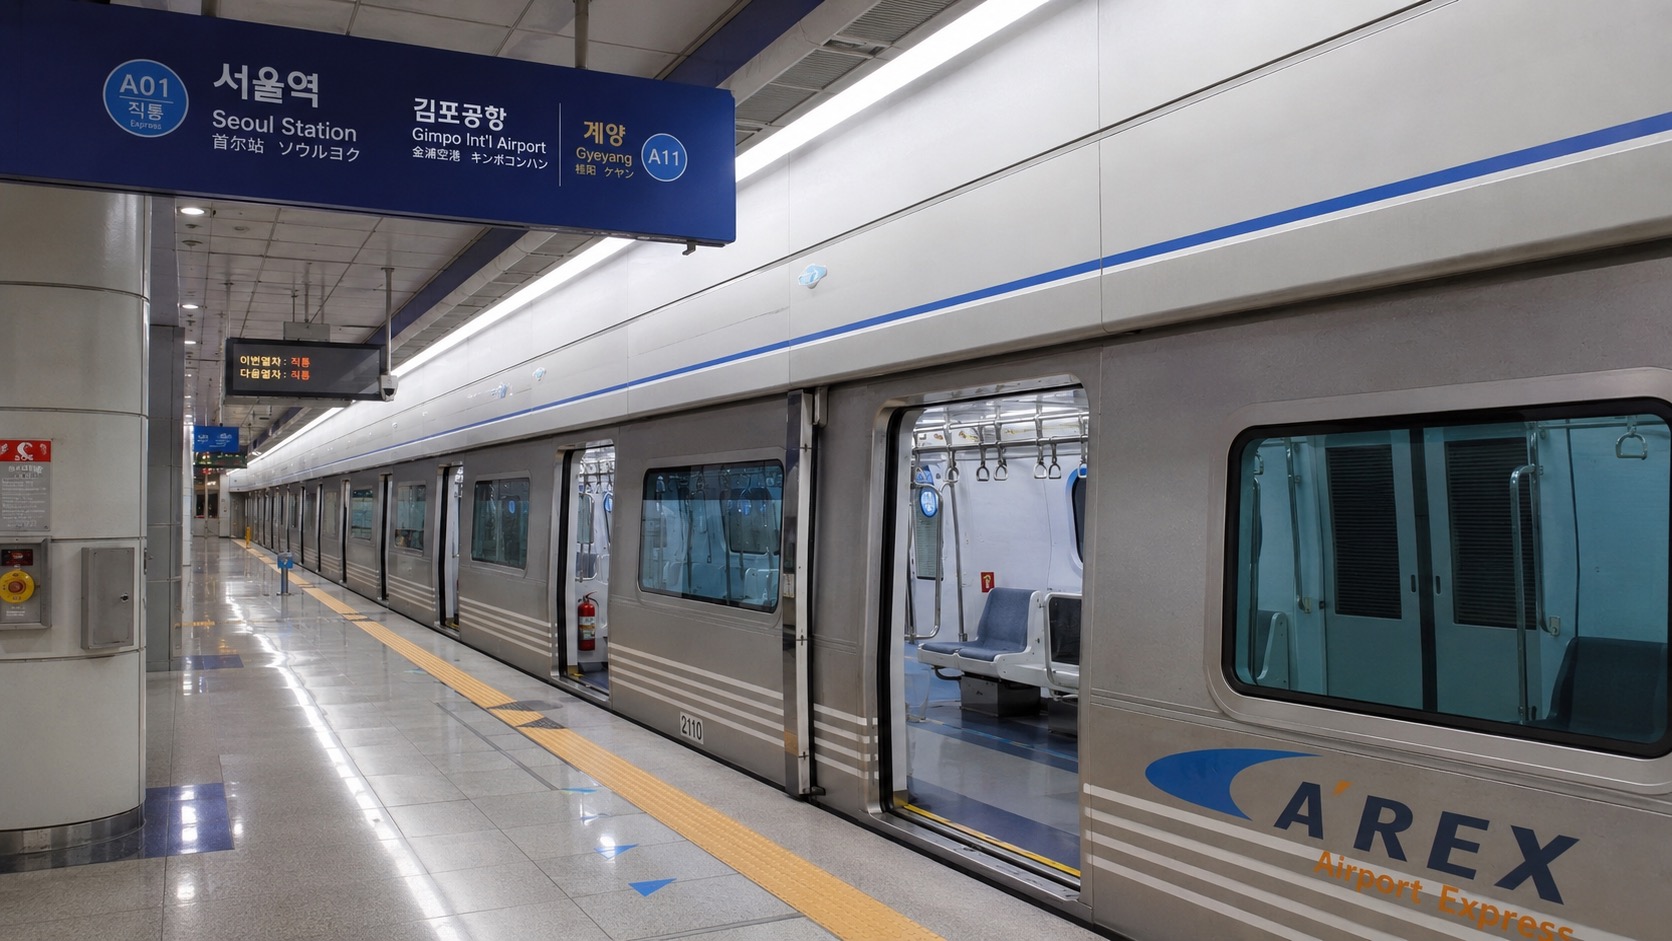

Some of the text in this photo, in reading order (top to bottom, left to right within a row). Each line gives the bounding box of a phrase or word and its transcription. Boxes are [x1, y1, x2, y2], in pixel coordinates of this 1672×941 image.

[119, 73, 168, 98] A01
[213, 63, 319, 108] 서울역
[128, 101, 164, 121] 직통
[413, 97, 506, 132] 김포공항
[212, 110, 357, 142] Seoul Station
[583, 120, 626, 147] 계양
[211, 133, 265, 155] 首尔站
[278, 141, 361, 163] ソウルヨク
[412, 128, 547, 154] Gimpo Int'l Airport
[575, 146, 633, 167] Gyeyang
[648, 148, 679, 166] A11
[604, 166, 635, 179] ケヤン
[681, 715, 702, 740] 2110
[1313, 849, 1576, 941] Airport Express
